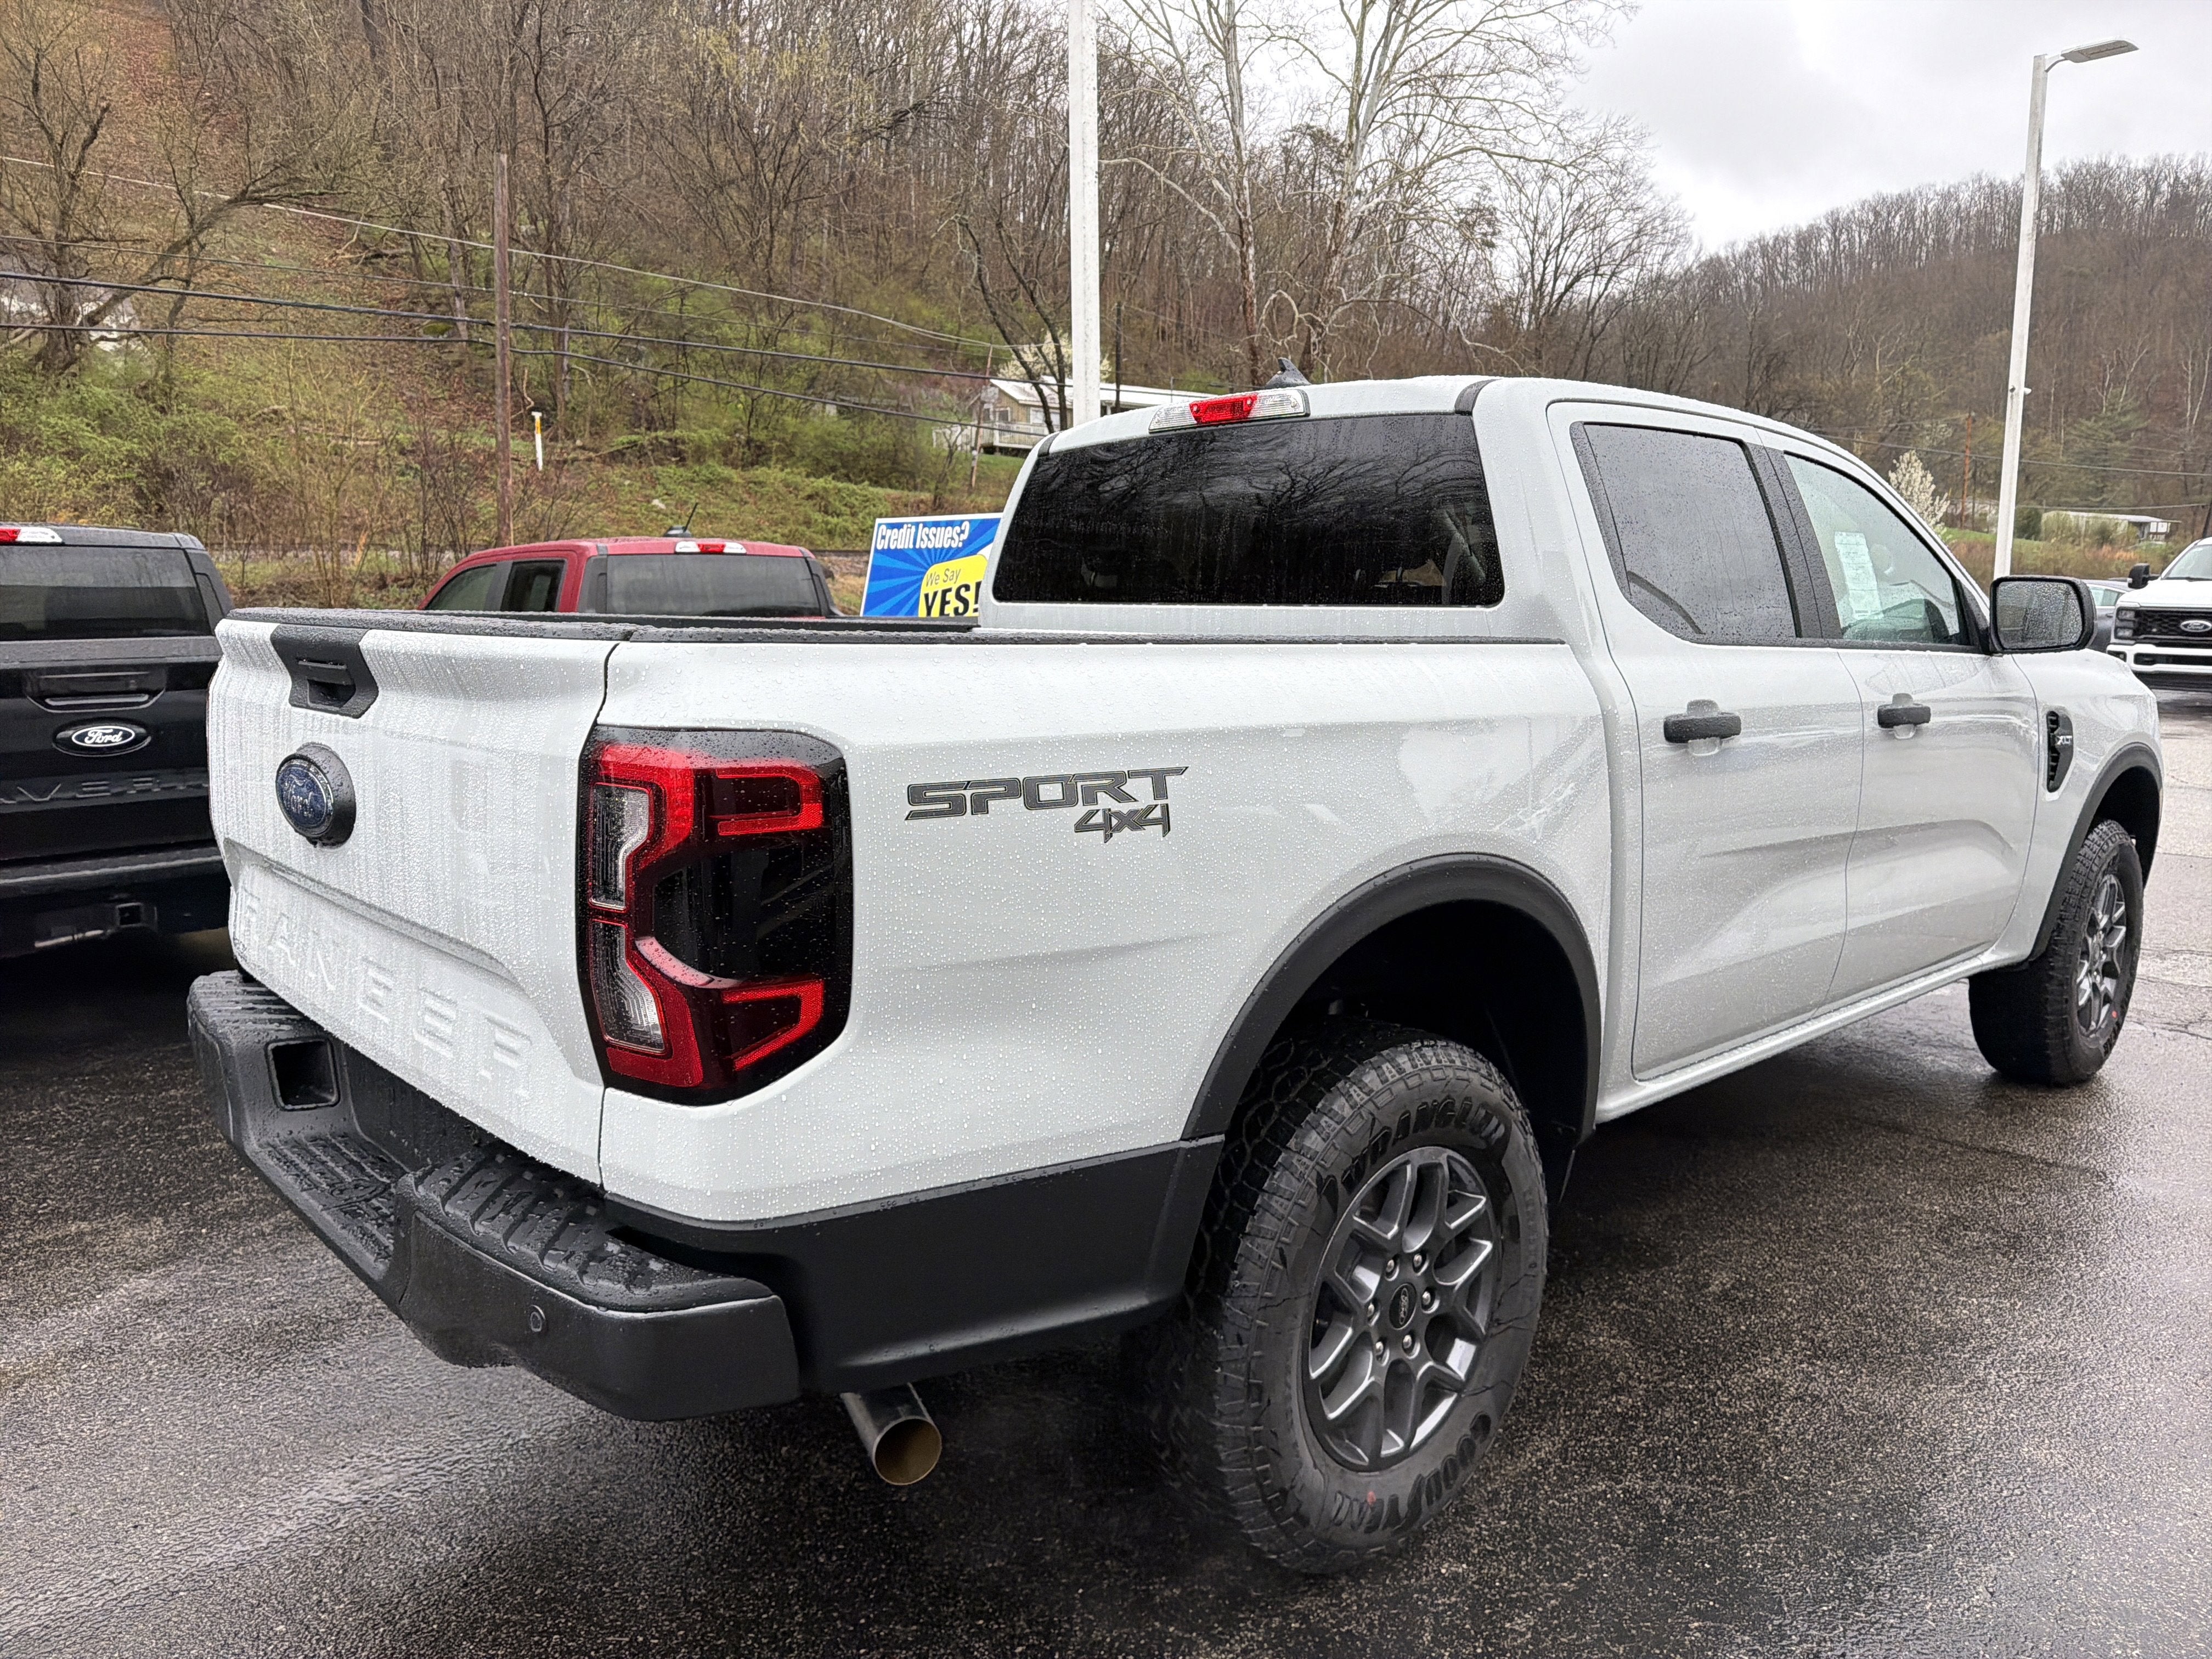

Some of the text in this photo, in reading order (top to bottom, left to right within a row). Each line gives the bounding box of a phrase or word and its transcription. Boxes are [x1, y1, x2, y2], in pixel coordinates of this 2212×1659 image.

[876, 521, 970, 550] Credit Issues?
[926, 568, 962, 588] We Say
[924, 580, 982, 617] YES!
[83, 727, 125, 744] Ford
[2055, 735, 2073, 746] XLT
[904, 766, 1189, 821] SPORT
[1074, 803, 1171, 844] 4x4
